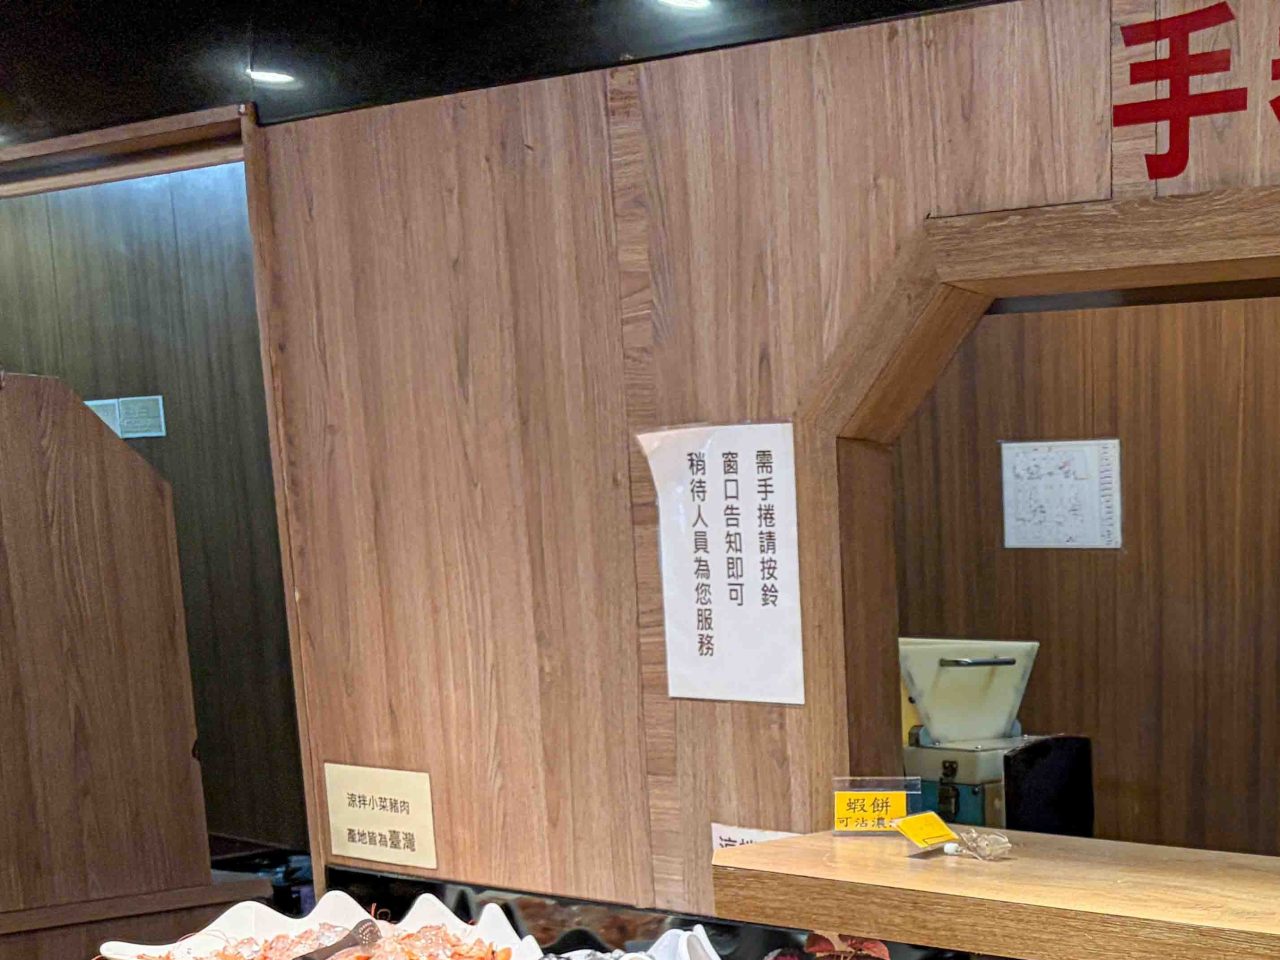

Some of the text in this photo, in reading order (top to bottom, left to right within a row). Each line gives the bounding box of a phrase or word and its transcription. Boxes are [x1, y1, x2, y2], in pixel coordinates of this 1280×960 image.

[686, 452, 714, 658] 稍待人員為您服務
[721, 451, 745, 607] 窗口告知即可
[755, 450, 779, 608] 需手捲請按鈴
[837, 815, 896, 829] 可沾濃
[846, 797, 891, 815] 蝦餅
